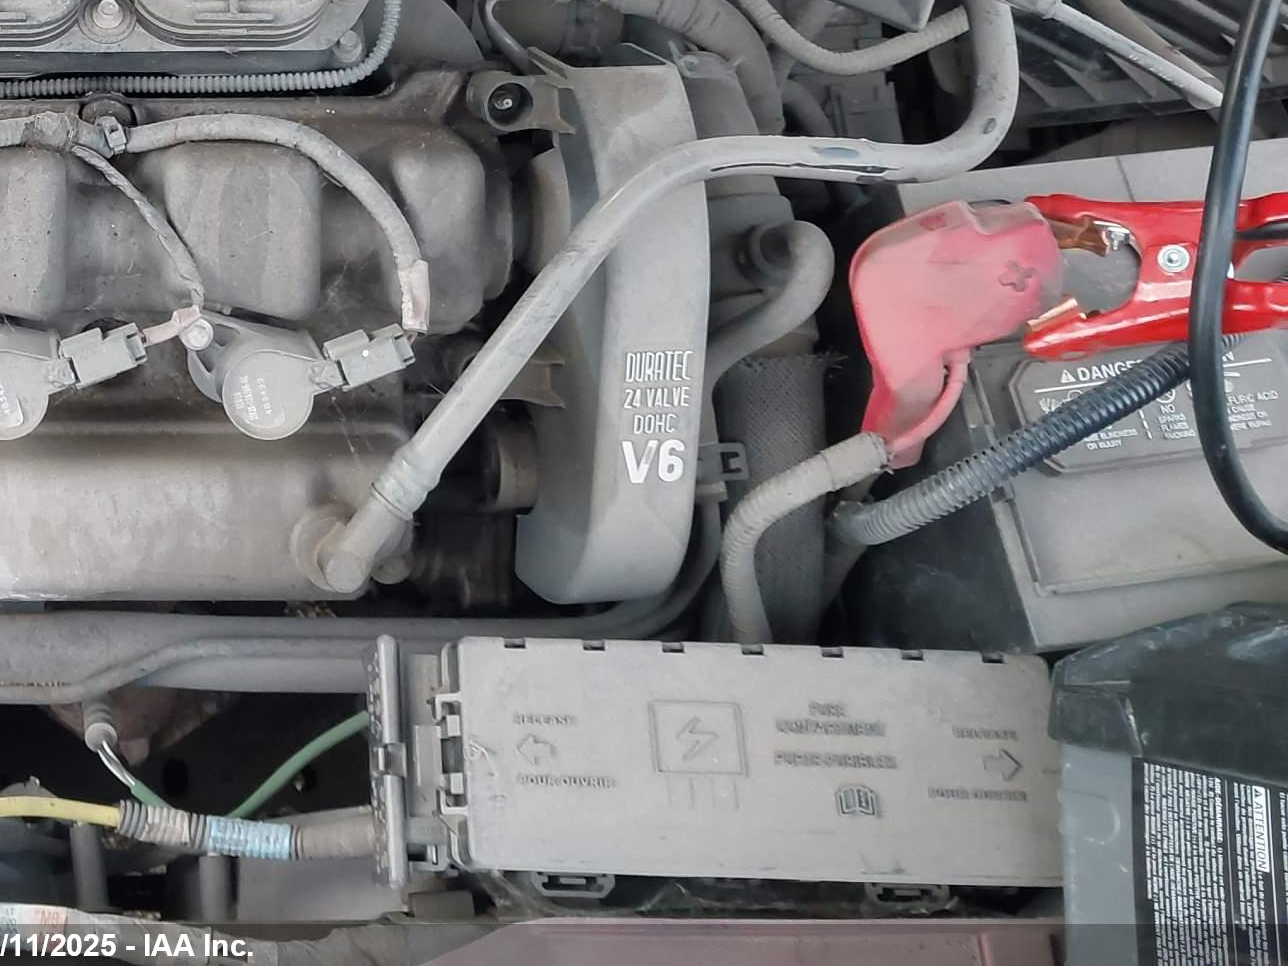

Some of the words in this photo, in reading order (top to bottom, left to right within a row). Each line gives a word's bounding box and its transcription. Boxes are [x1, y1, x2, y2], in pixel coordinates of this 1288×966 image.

[624, 350, 694, 383] DURATEC
[1077, 359, 1143, 381] DANGE
[623, 388, 642, 409] 24
[646, 386, 691, 408] VALVE
[1160, 404, 1176, 414] NO
[633, 413, 678, 435] DOHC
[621, 438, 686, 484] V6
[1253, 801, 1268, 870] ATTENTION
